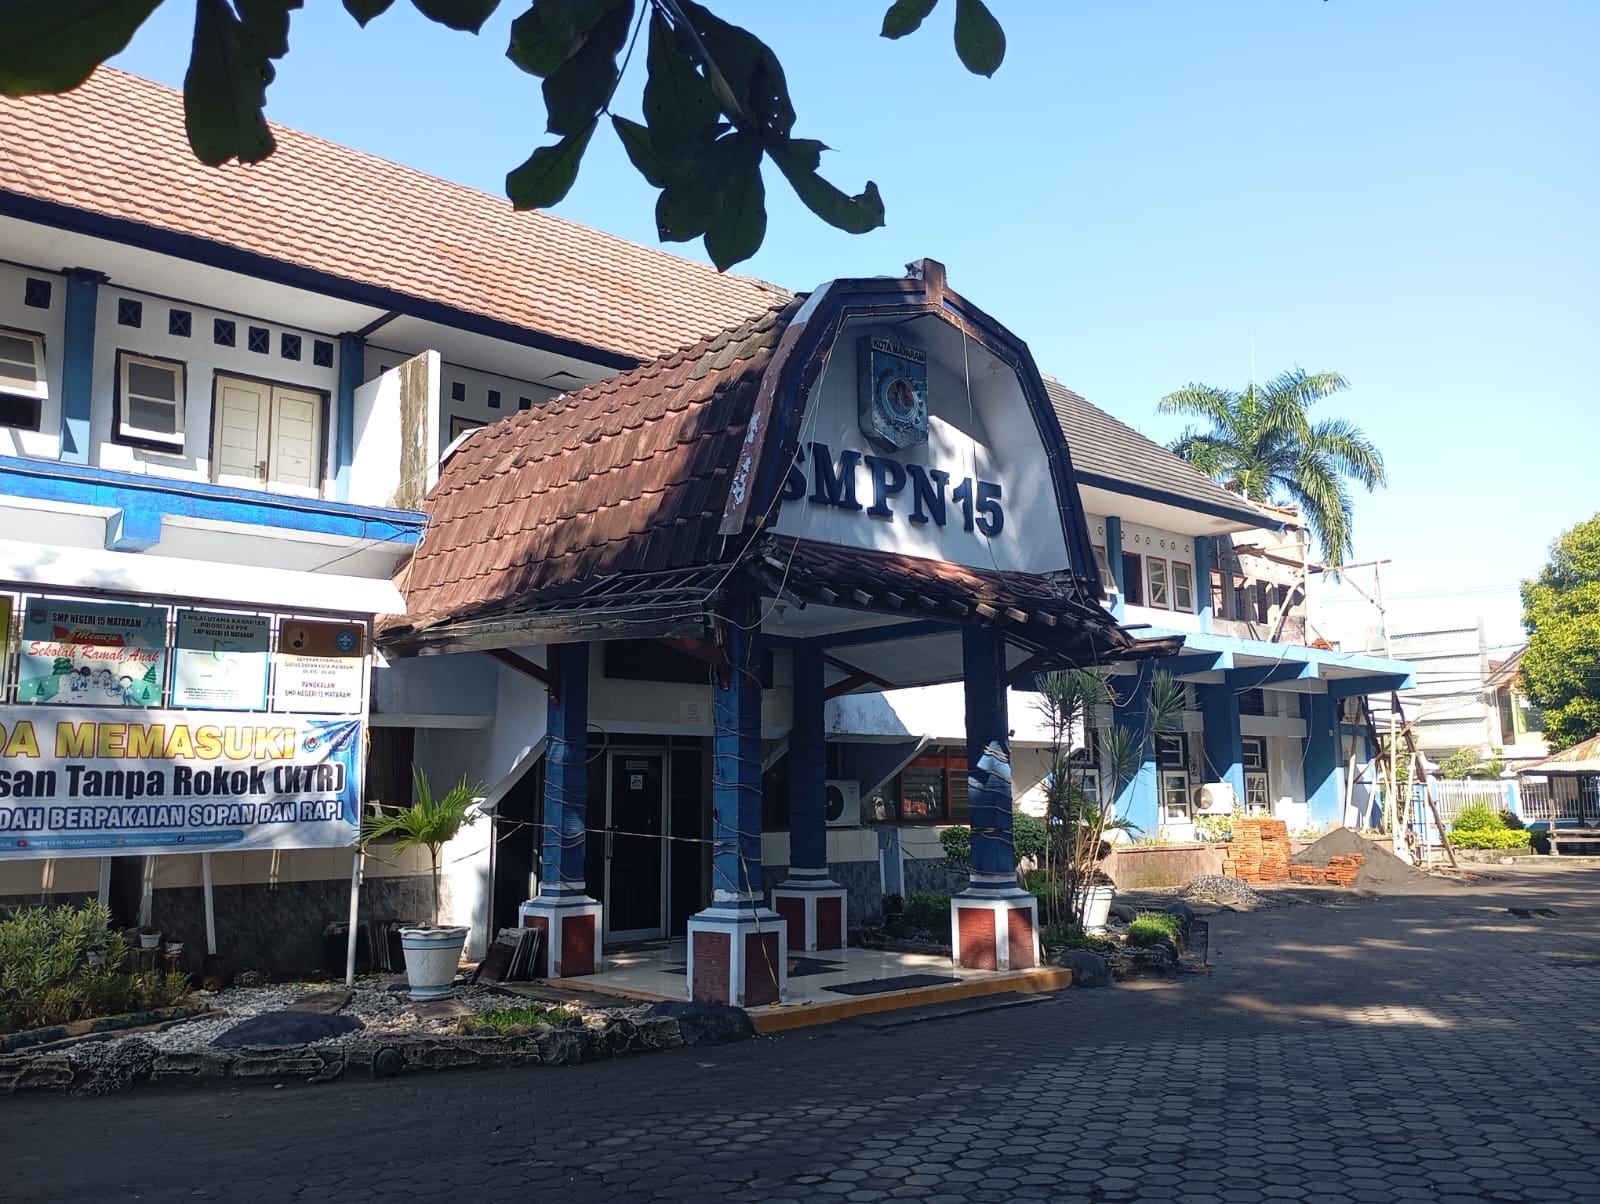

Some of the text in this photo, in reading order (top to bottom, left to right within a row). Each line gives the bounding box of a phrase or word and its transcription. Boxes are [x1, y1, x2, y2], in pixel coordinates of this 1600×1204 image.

[873, 338, 926, 362] KOTA MATARAM
[784, 442, 1004, 537] SMPN 15
[52, 612, 142, 628] SMP NEGERI 15 MATARAM
[200, 622, 235, 630] PRIORITAS
[27, 640, 161, 662] Sekolah Ramah Anak
[301, 681, 336, 689] PANGKALAN
[324, 691, 352, 699] MATARAM
[0, 720, 296, 760] A MEMASUKI
[66, 765, 165, 800] Tanpa
[173, 765, 267, 796] Rokok
[273, 763, 344, 794] (KTR)
[48, 805, 186, 831] BERPAKAIAN
[188, 803, 255, 827] SOPAN
[257, 801, 297, 825] DAN
[300, 799, 344, 823] RAPI
